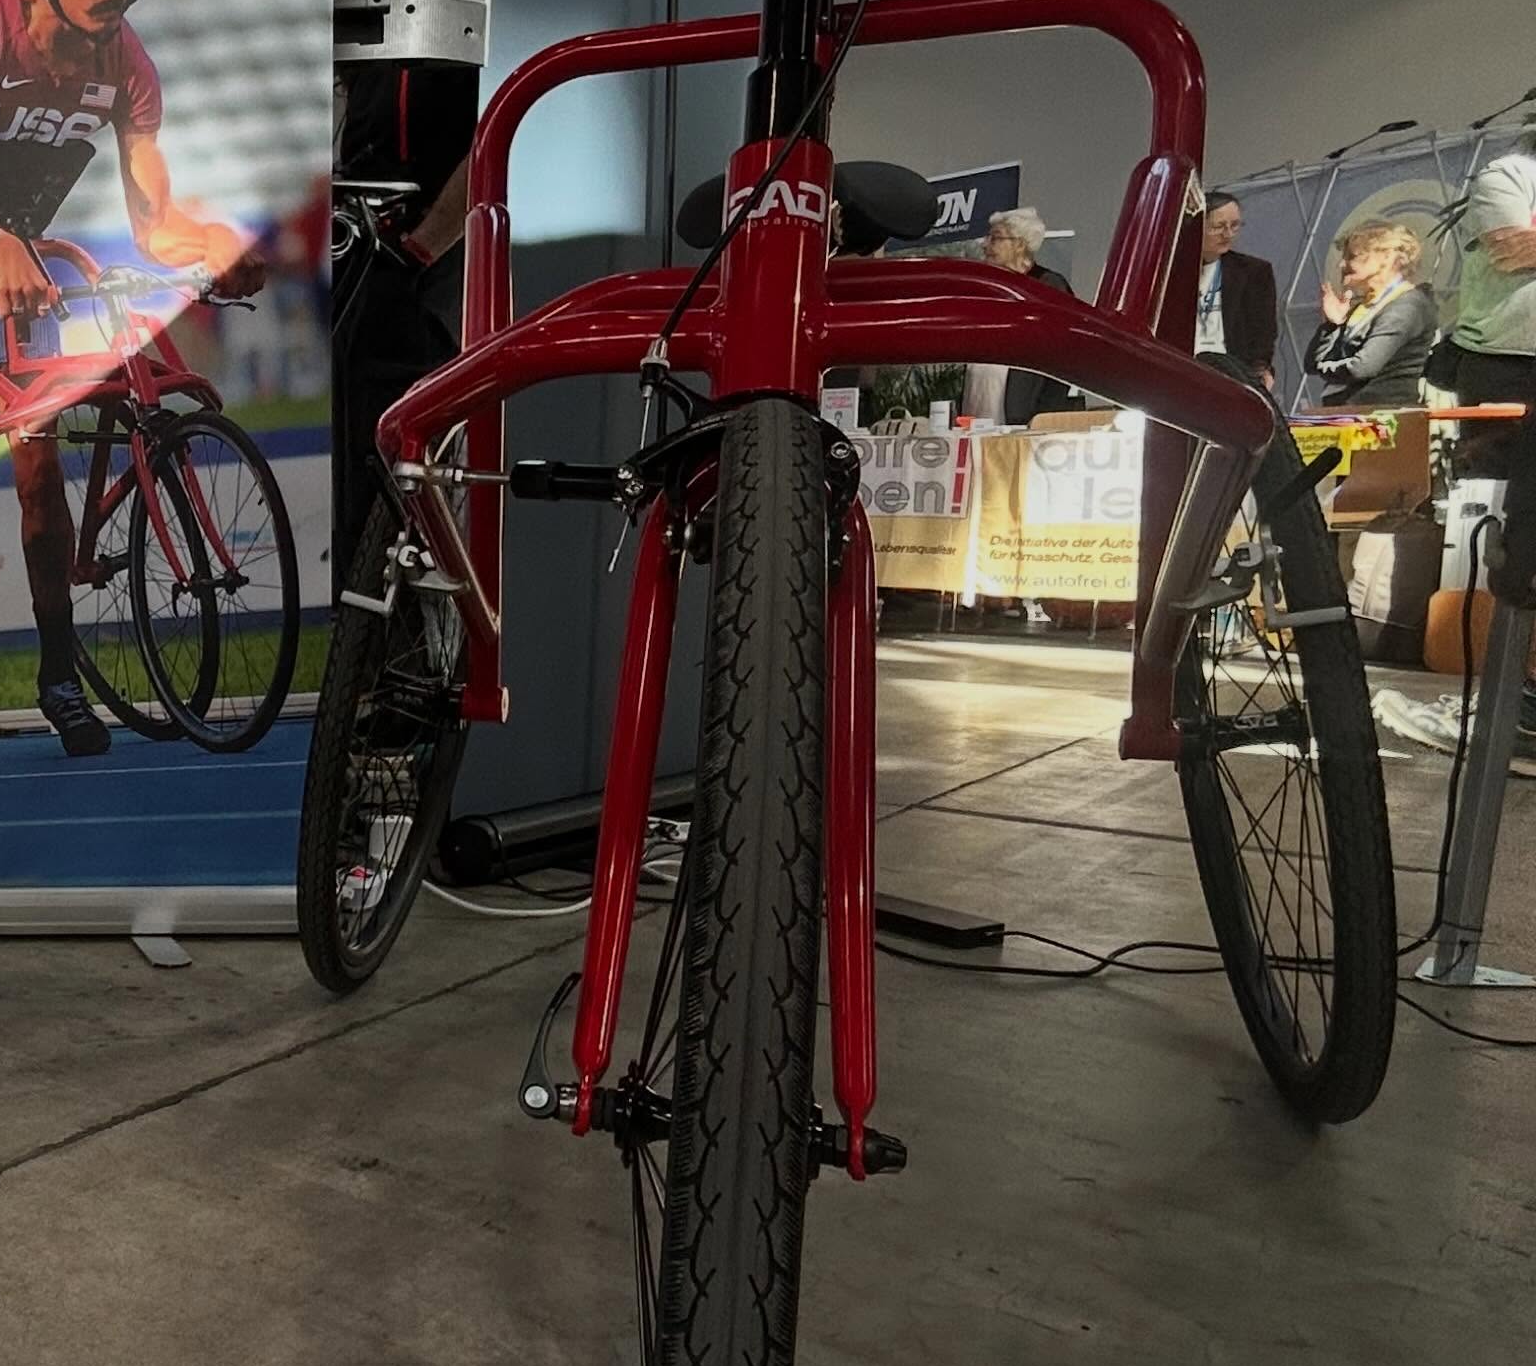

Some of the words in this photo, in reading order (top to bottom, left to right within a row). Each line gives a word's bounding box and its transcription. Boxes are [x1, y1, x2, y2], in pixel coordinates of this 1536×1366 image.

[933, 187, 978, 227] ON
[1071, 536, 1097, 548] der
[1099, 537, 1135, 549] Auto
